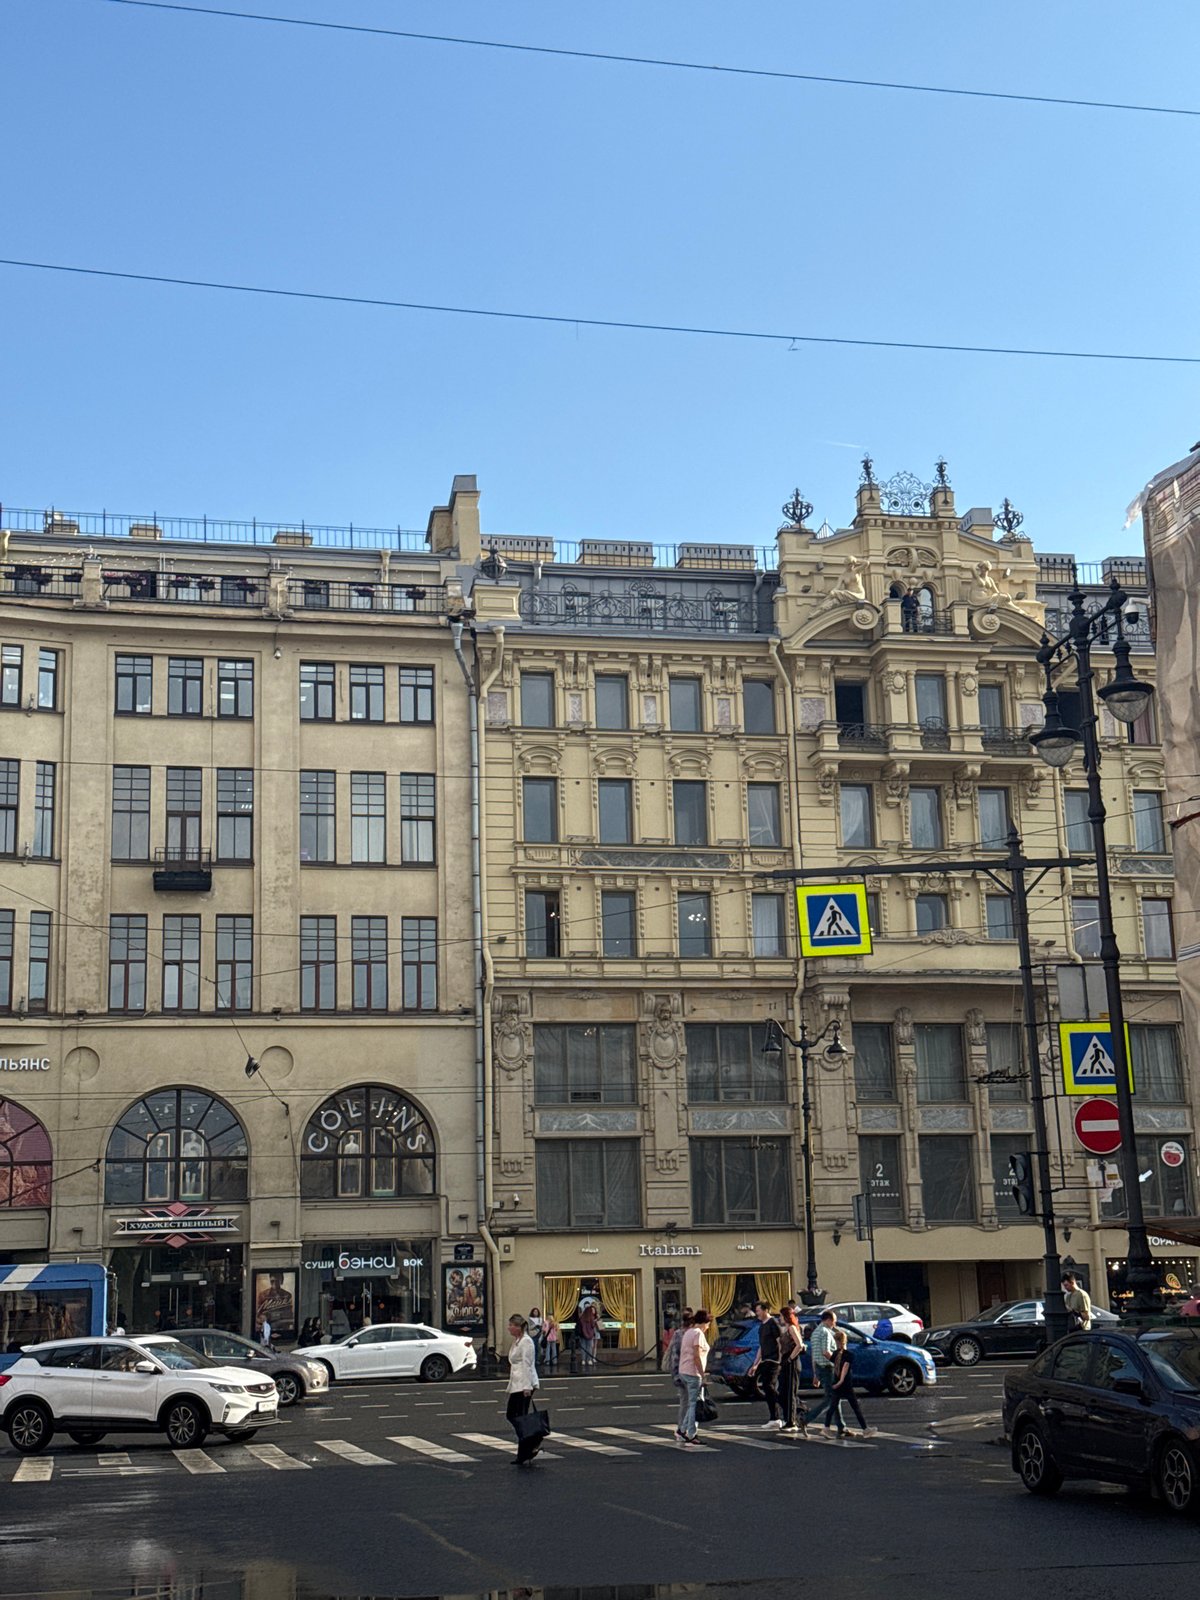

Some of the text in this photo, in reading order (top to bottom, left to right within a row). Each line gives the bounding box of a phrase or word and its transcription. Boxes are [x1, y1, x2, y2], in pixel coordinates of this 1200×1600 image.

[875, 1163, 884, 1177] 2
[129, 1219, 226, 1229] ХУДОЖЕСТВЕННЫЙ
[639, 1244, 703, 1256] Italiani
